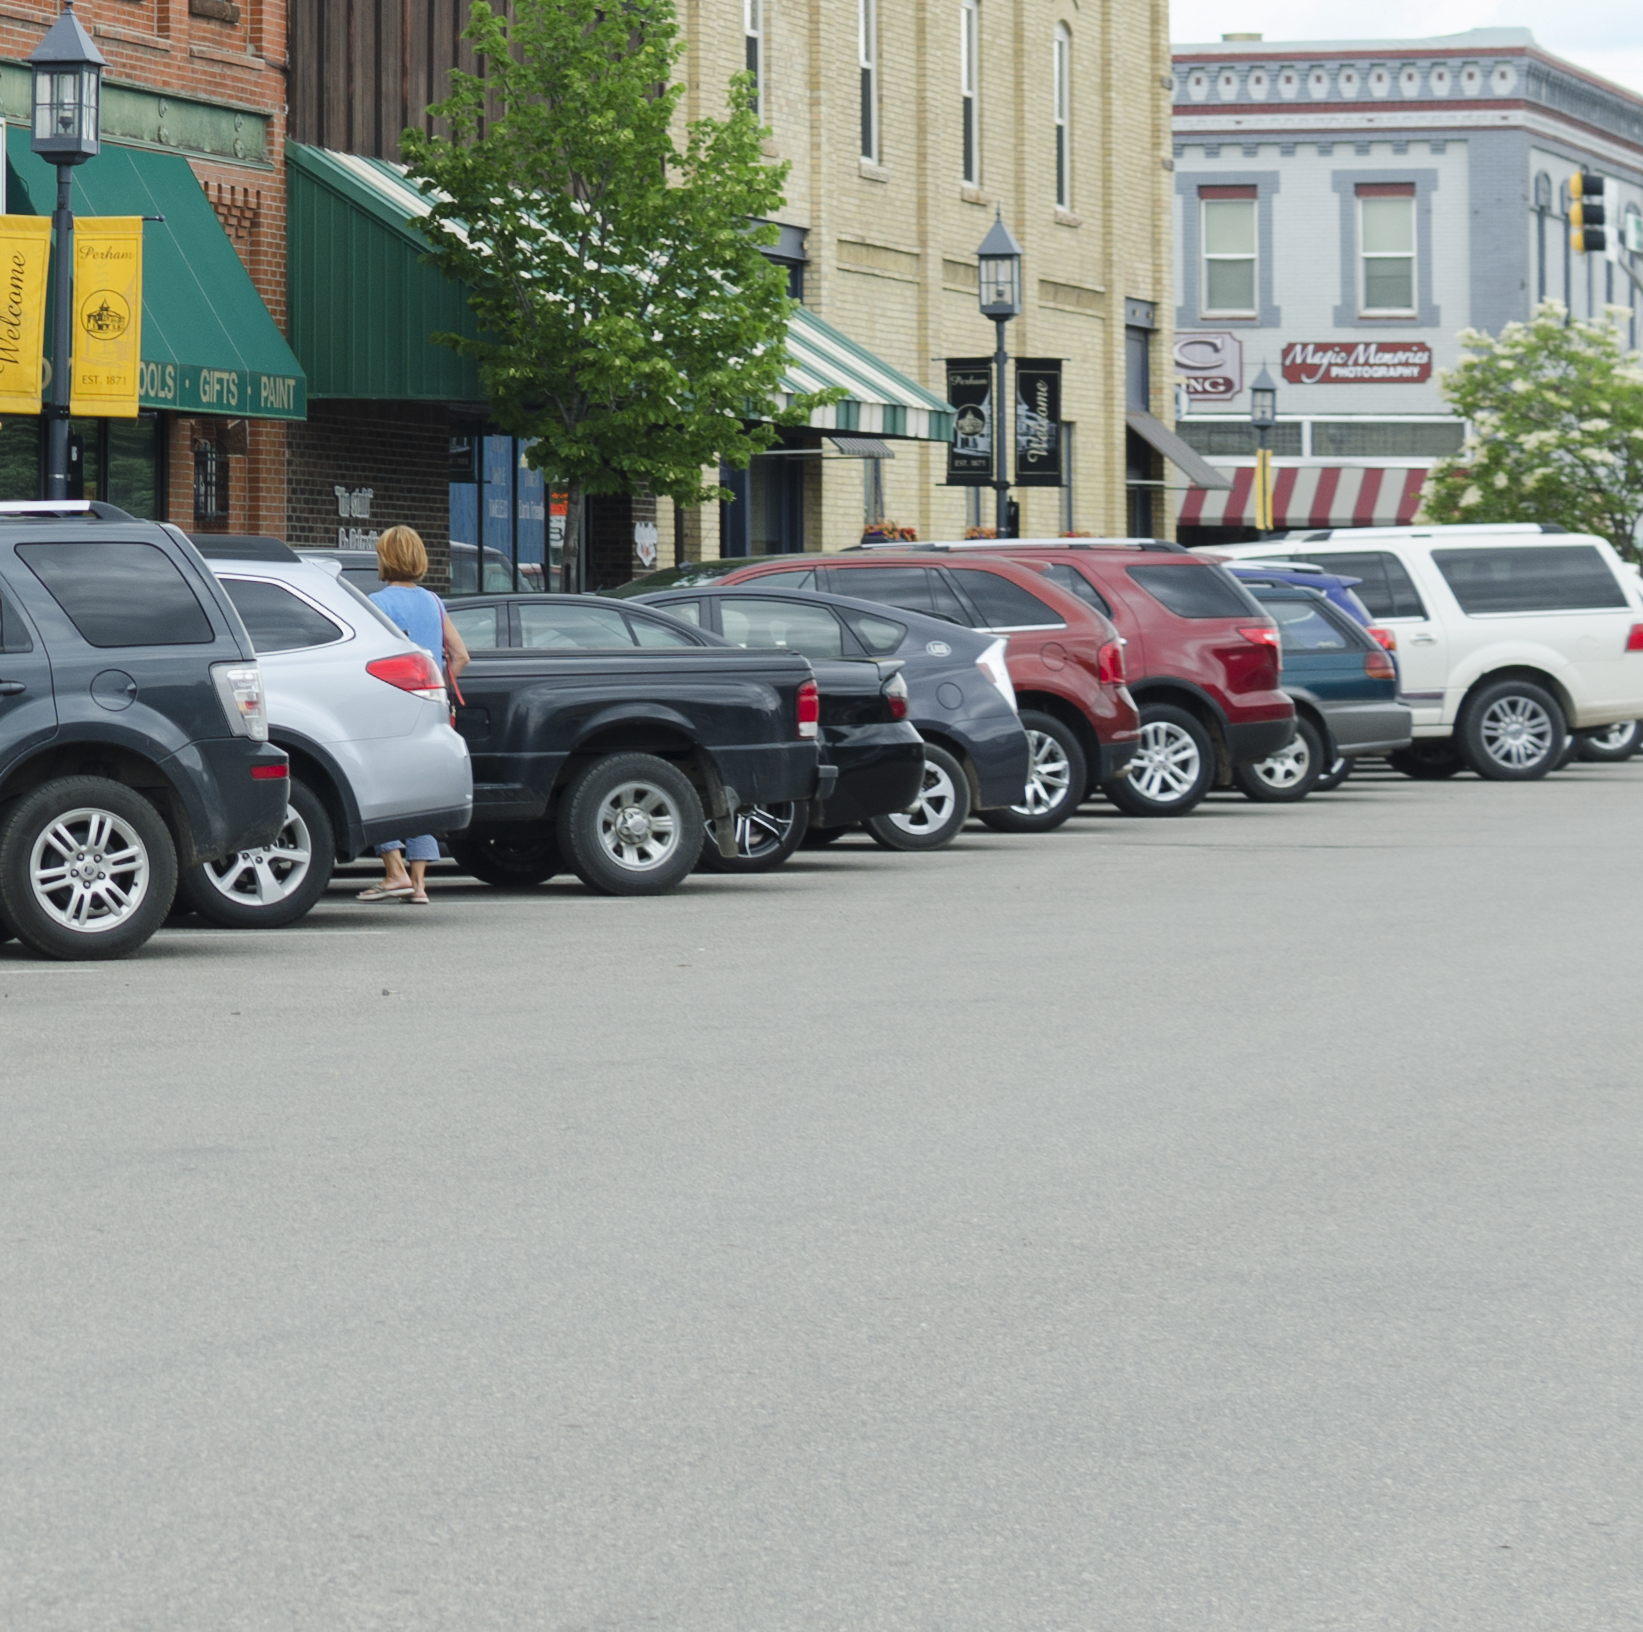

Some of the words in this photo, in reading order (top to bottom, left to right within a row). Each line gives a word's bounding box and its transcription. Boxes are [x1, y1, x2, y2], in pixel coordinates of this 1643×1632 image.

[78, 245, 135, 261] Perham
[1284, 343, 1347, 384] Magic
[1348, 342, 1430, 365] Memories
[1330, 366, 1421, 379] PHOTOGRAPHY
[82, 375, 101, 385] EST.
[106, 374, 127, 385] 1871
[200, 368, 238, 407] GIFTS
[260, 375, 296, 410] PAINT
[1027, 379, 1049, 463] Welcome
